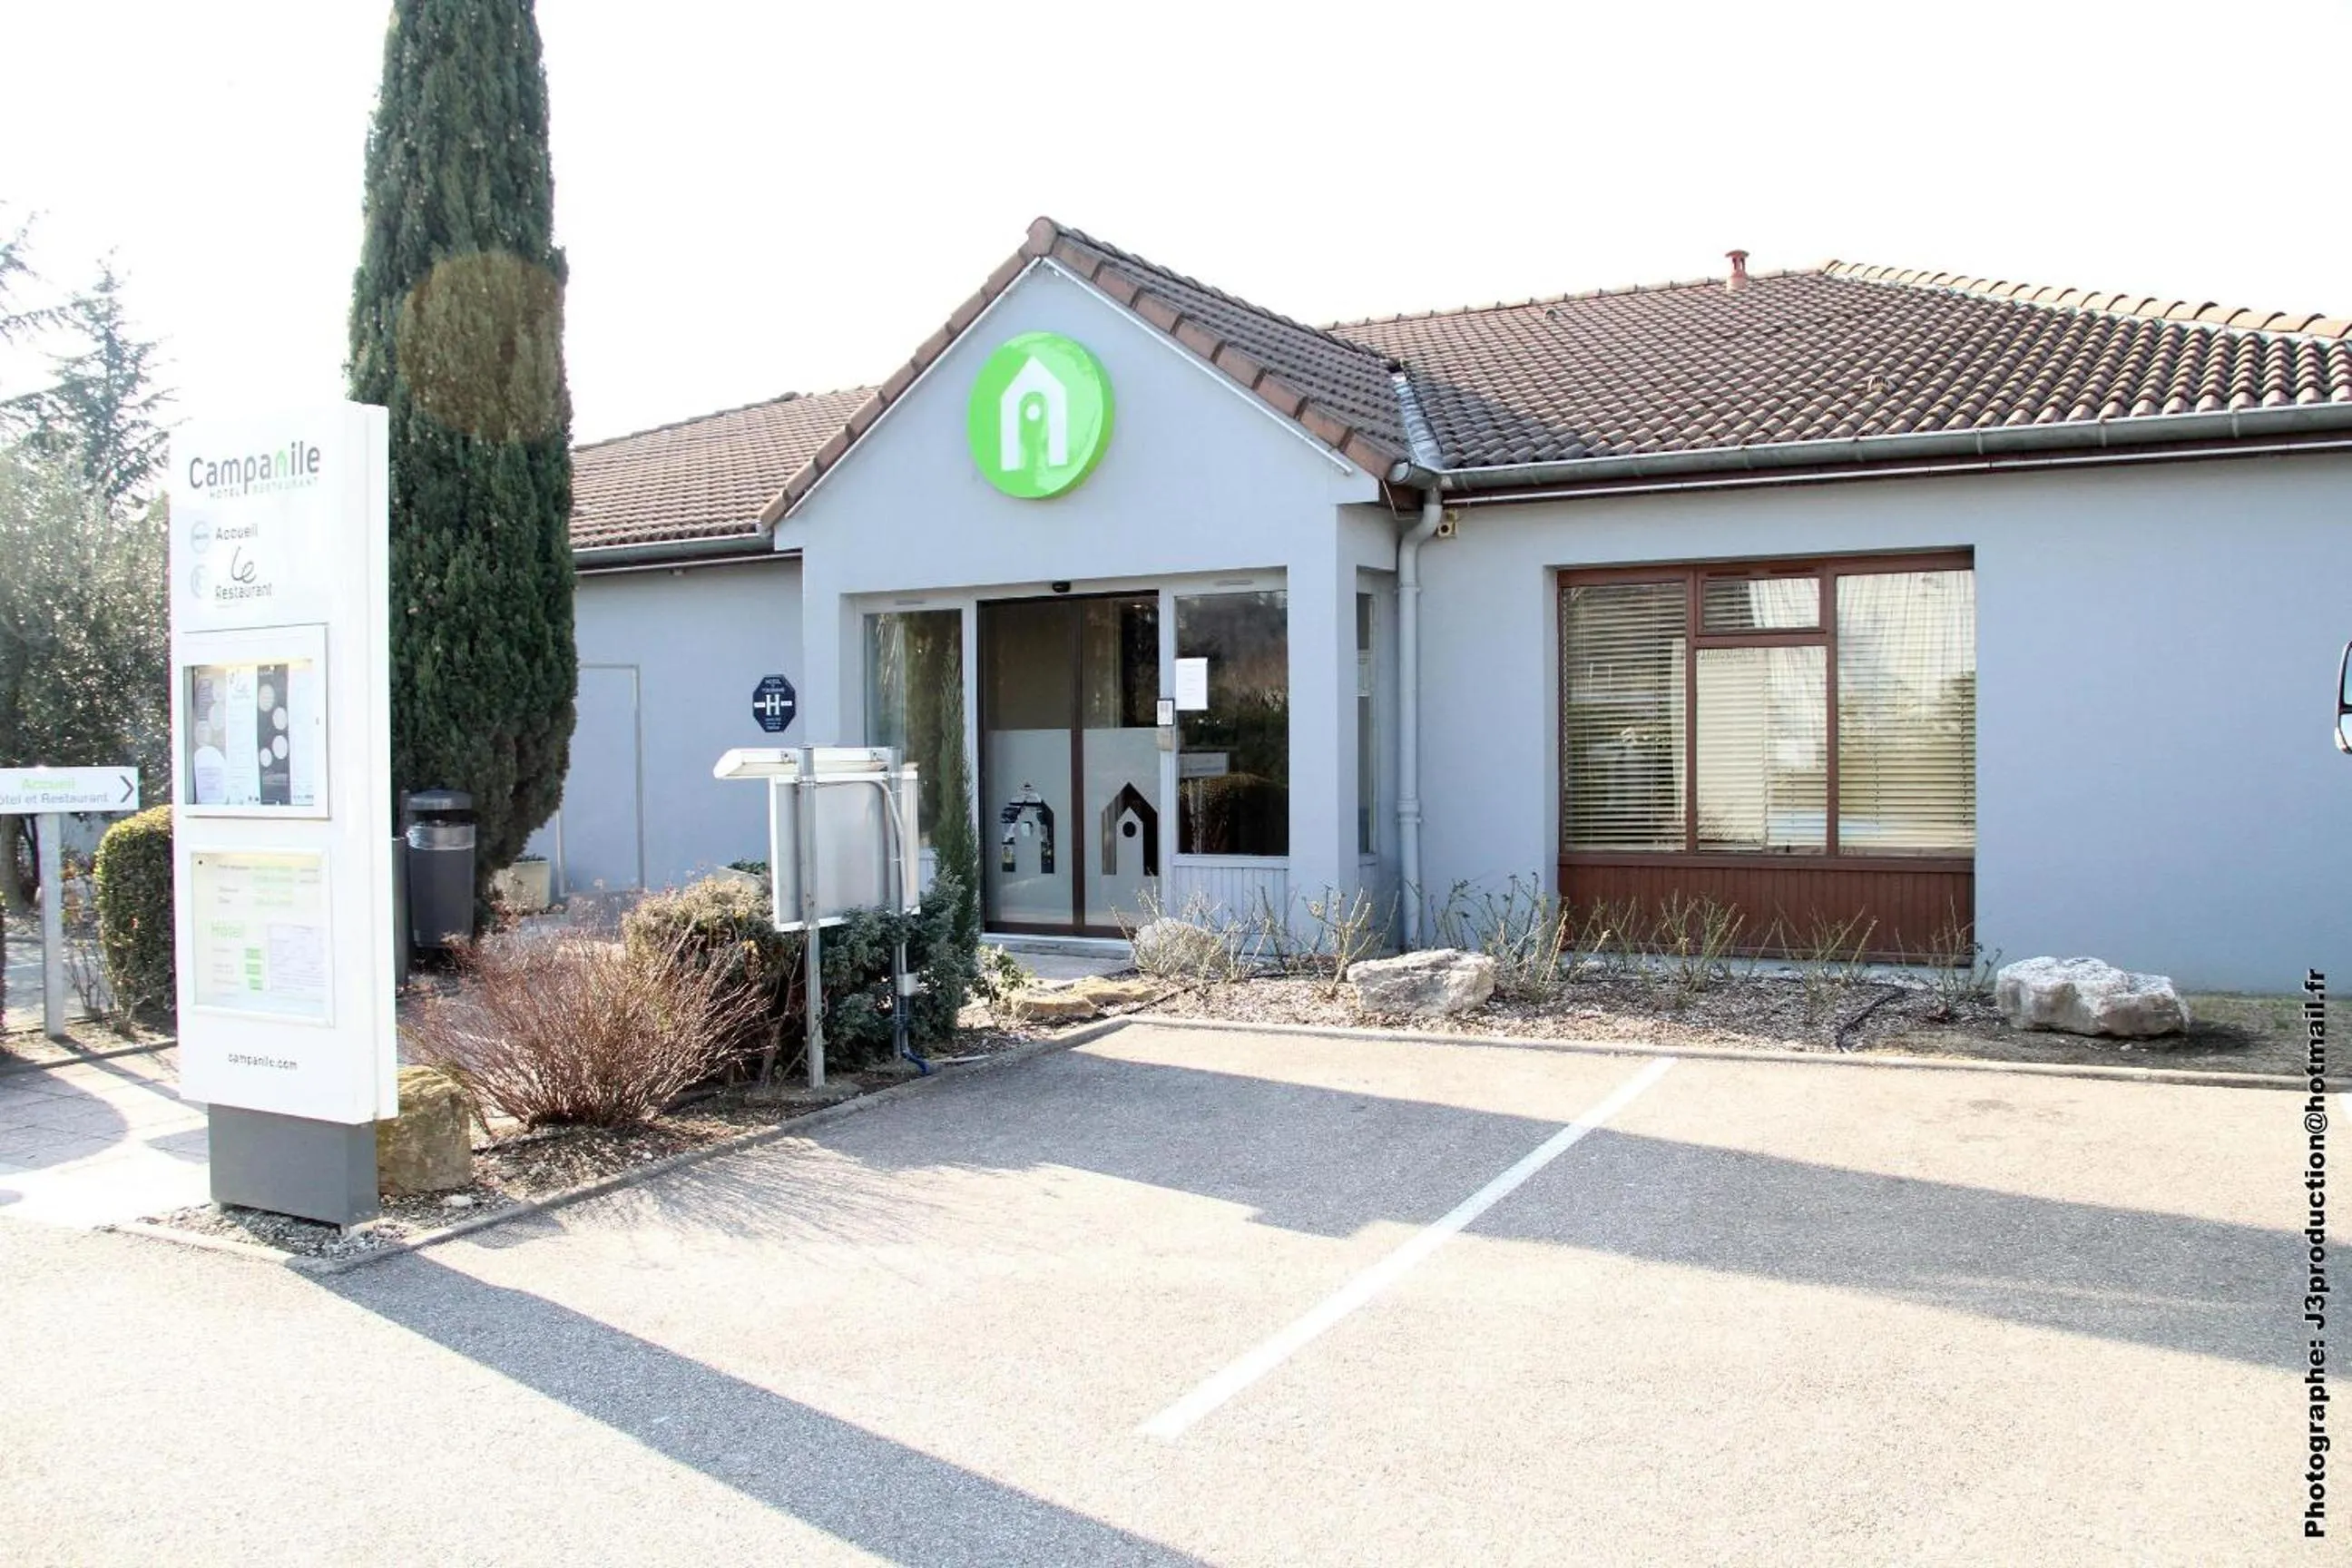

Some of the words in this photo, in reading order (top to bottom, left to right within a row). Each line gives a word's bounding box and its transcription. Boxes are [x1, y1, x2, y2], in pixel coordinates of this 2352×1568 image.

[189, 441, 320, 495] Campanile
[215, 524, 259, 541] Accueil
[215, 583, 272, 601] Restaurant
[41, 792, 109, 804] Restaurant
[228, 1053, 298, 1071] campanile.com
